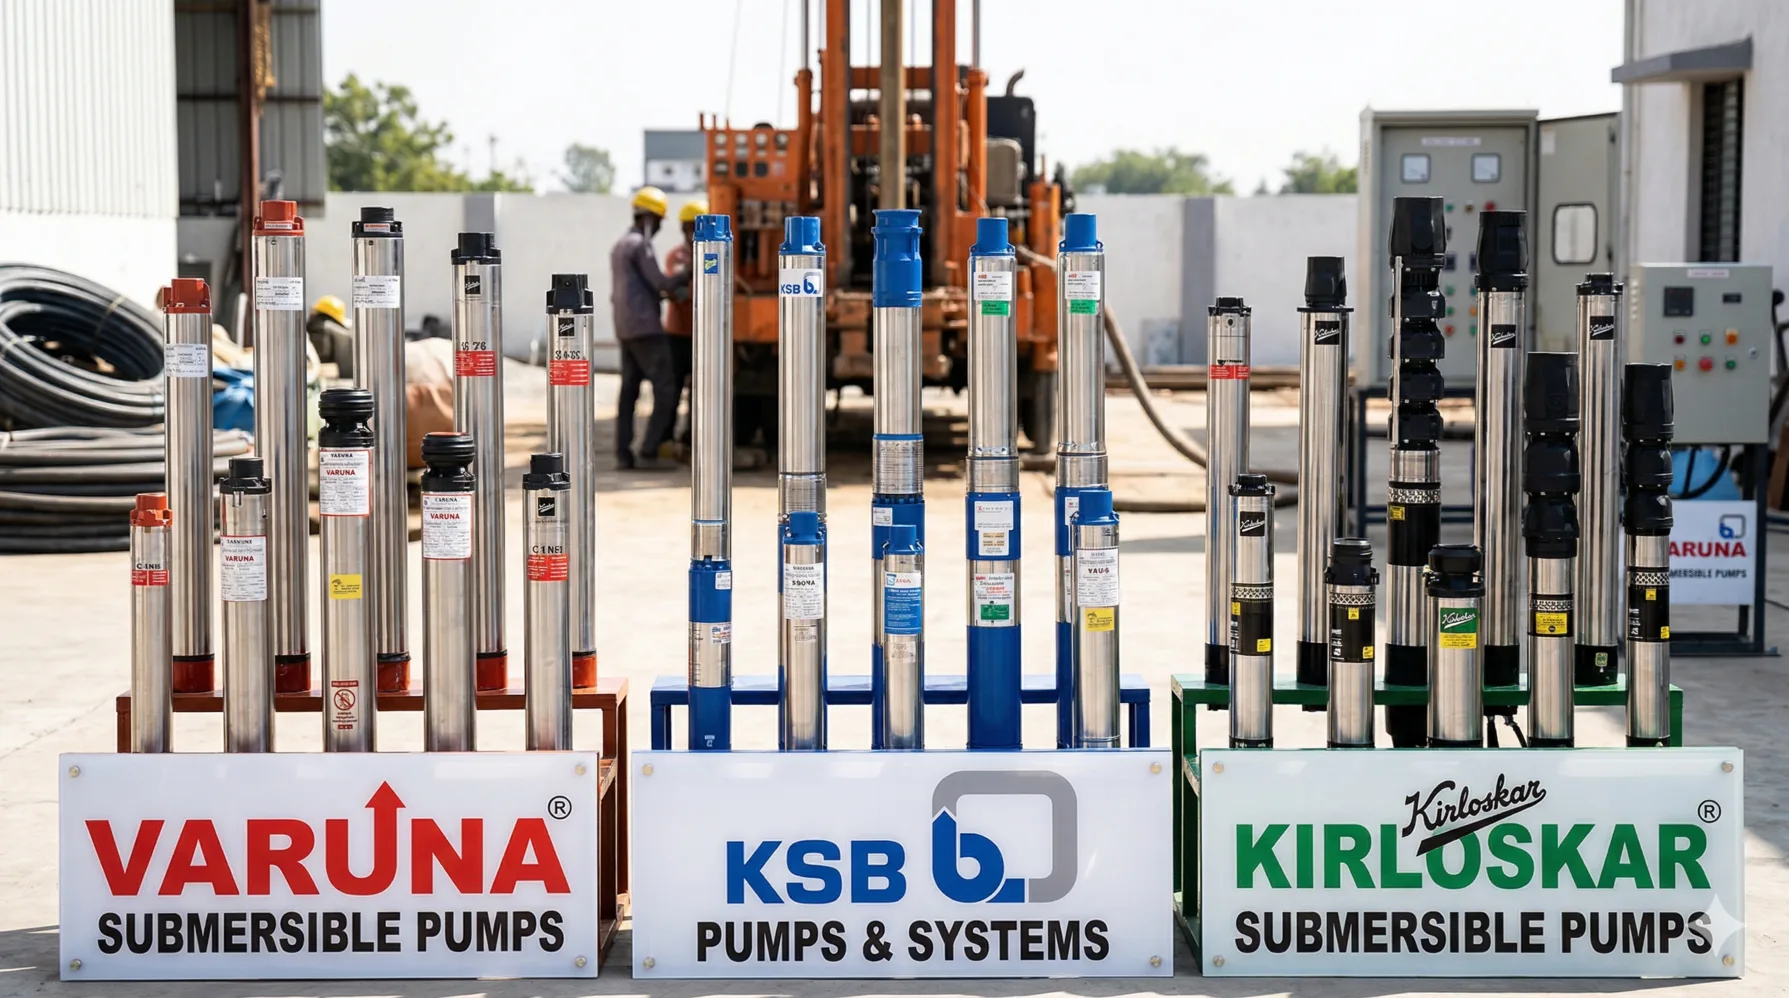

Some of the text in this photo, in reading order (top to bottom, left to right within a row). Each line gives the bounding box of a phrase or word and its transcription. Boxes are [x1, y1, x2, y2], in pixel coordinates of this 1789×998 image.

[780, 284, 801, 295] KSB
[1669, 541, 1747, 558] ARUNA
[1669, 568, 1747, 578] MERSIBLE PUMPS
[1401, 773, 1547, 842] Kirloskar
[85, 781, 571, 896] VARUNA
[1236, 823, 1712, 890] KIRLOSKAR
[726, 839, 907, 905] KSB
[97, 910, 564, 954] SUBMERSIBLE PUMPS
[697, 919, 1110, 962] PUMPS & SYSTEMS
[1234, 911, 1712, 954] SUBMERSIBLE PUMPS
